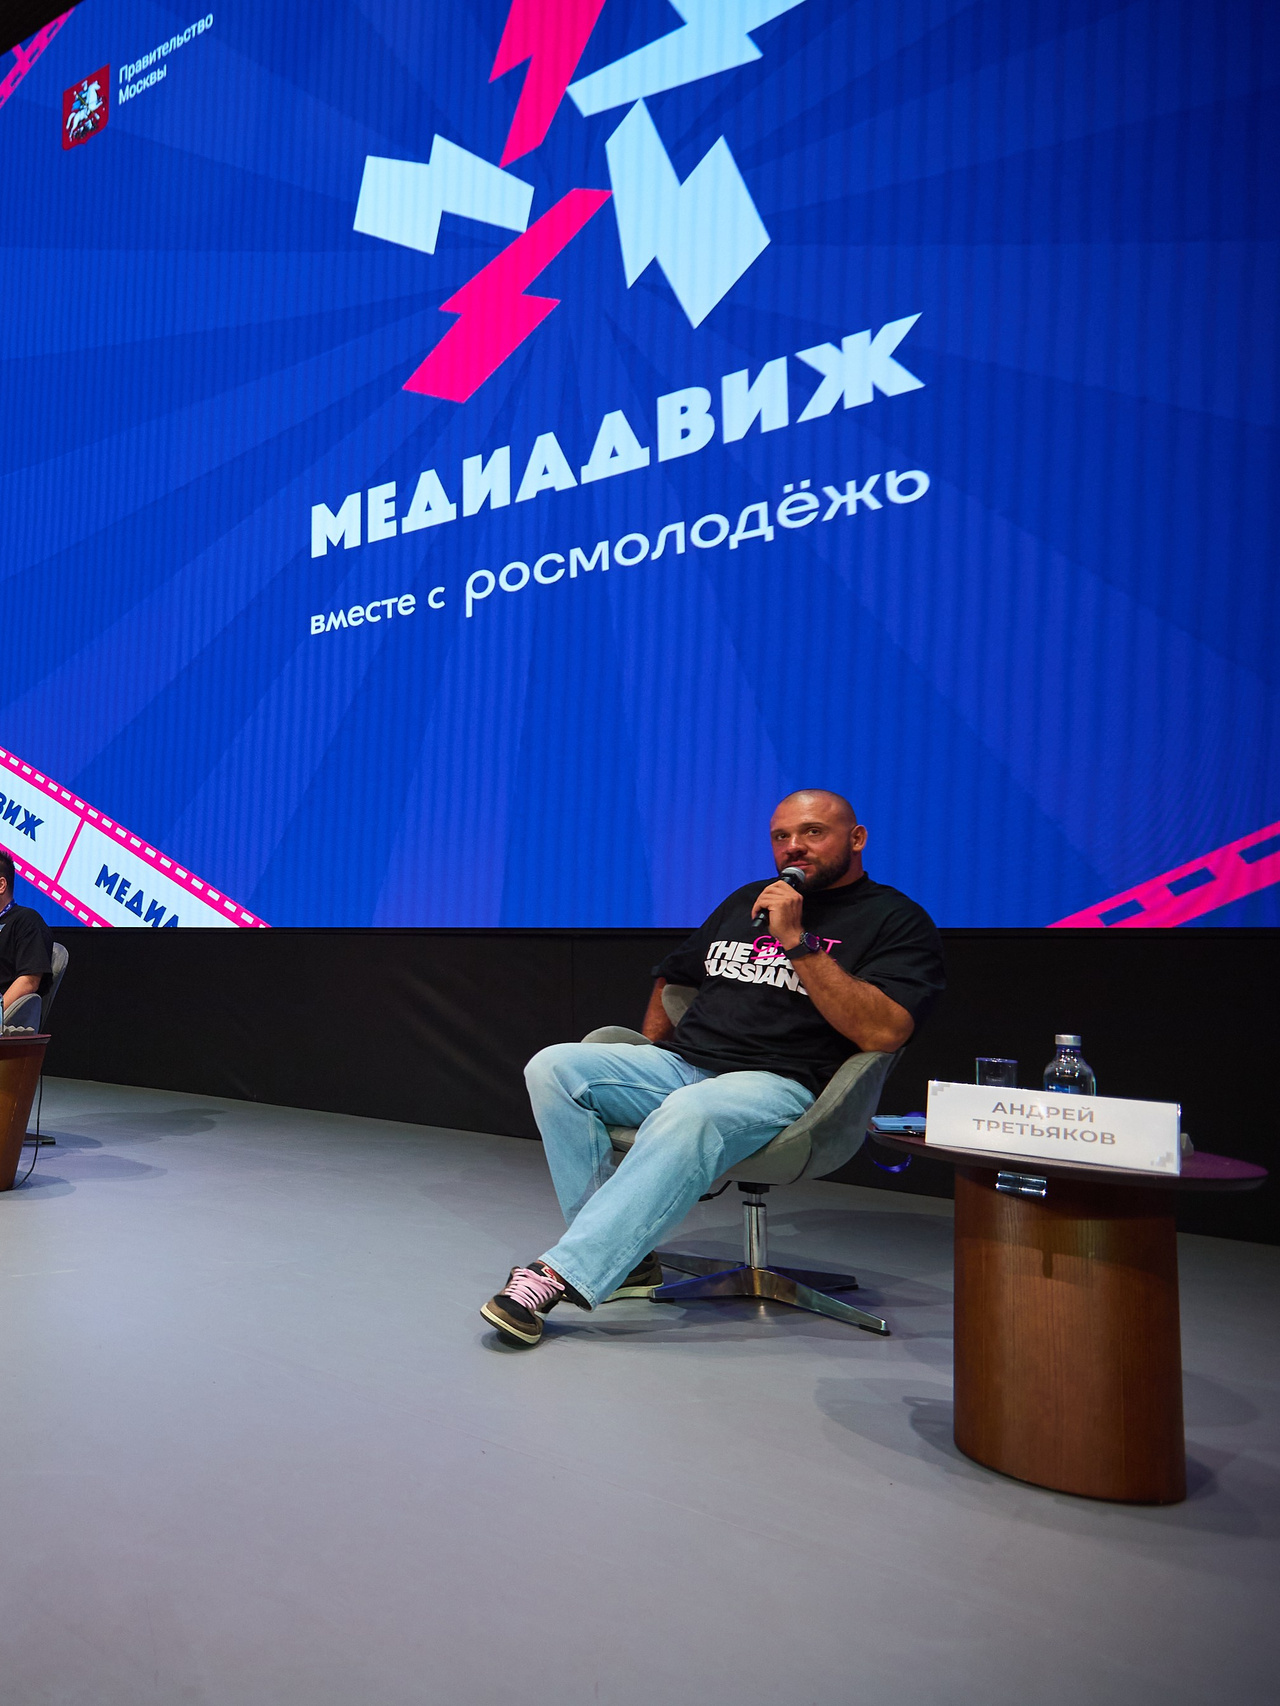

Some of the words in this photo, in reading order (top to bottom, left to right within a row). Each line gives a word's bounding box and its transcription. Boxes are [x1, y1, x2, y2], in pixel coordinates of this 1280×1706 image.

[118, 13, 214, 84] Правительство
[118, 64, 167, 105] Москвы
[310, 312, 926, 559] МЕДИАДВИЖ
[310, 591, 417, 636] вместе
[427, 586, 446, 610] с
[464, 468, 931, 617] росмолодёжь
[706, 940, 754, 963] THE
[753, 945, 797, 971] BA
[972, 1118, 1116, 1145] ТРЕТЬЯКОВ
[991, 1101, 1095, 1123] АНДРЕЙ
